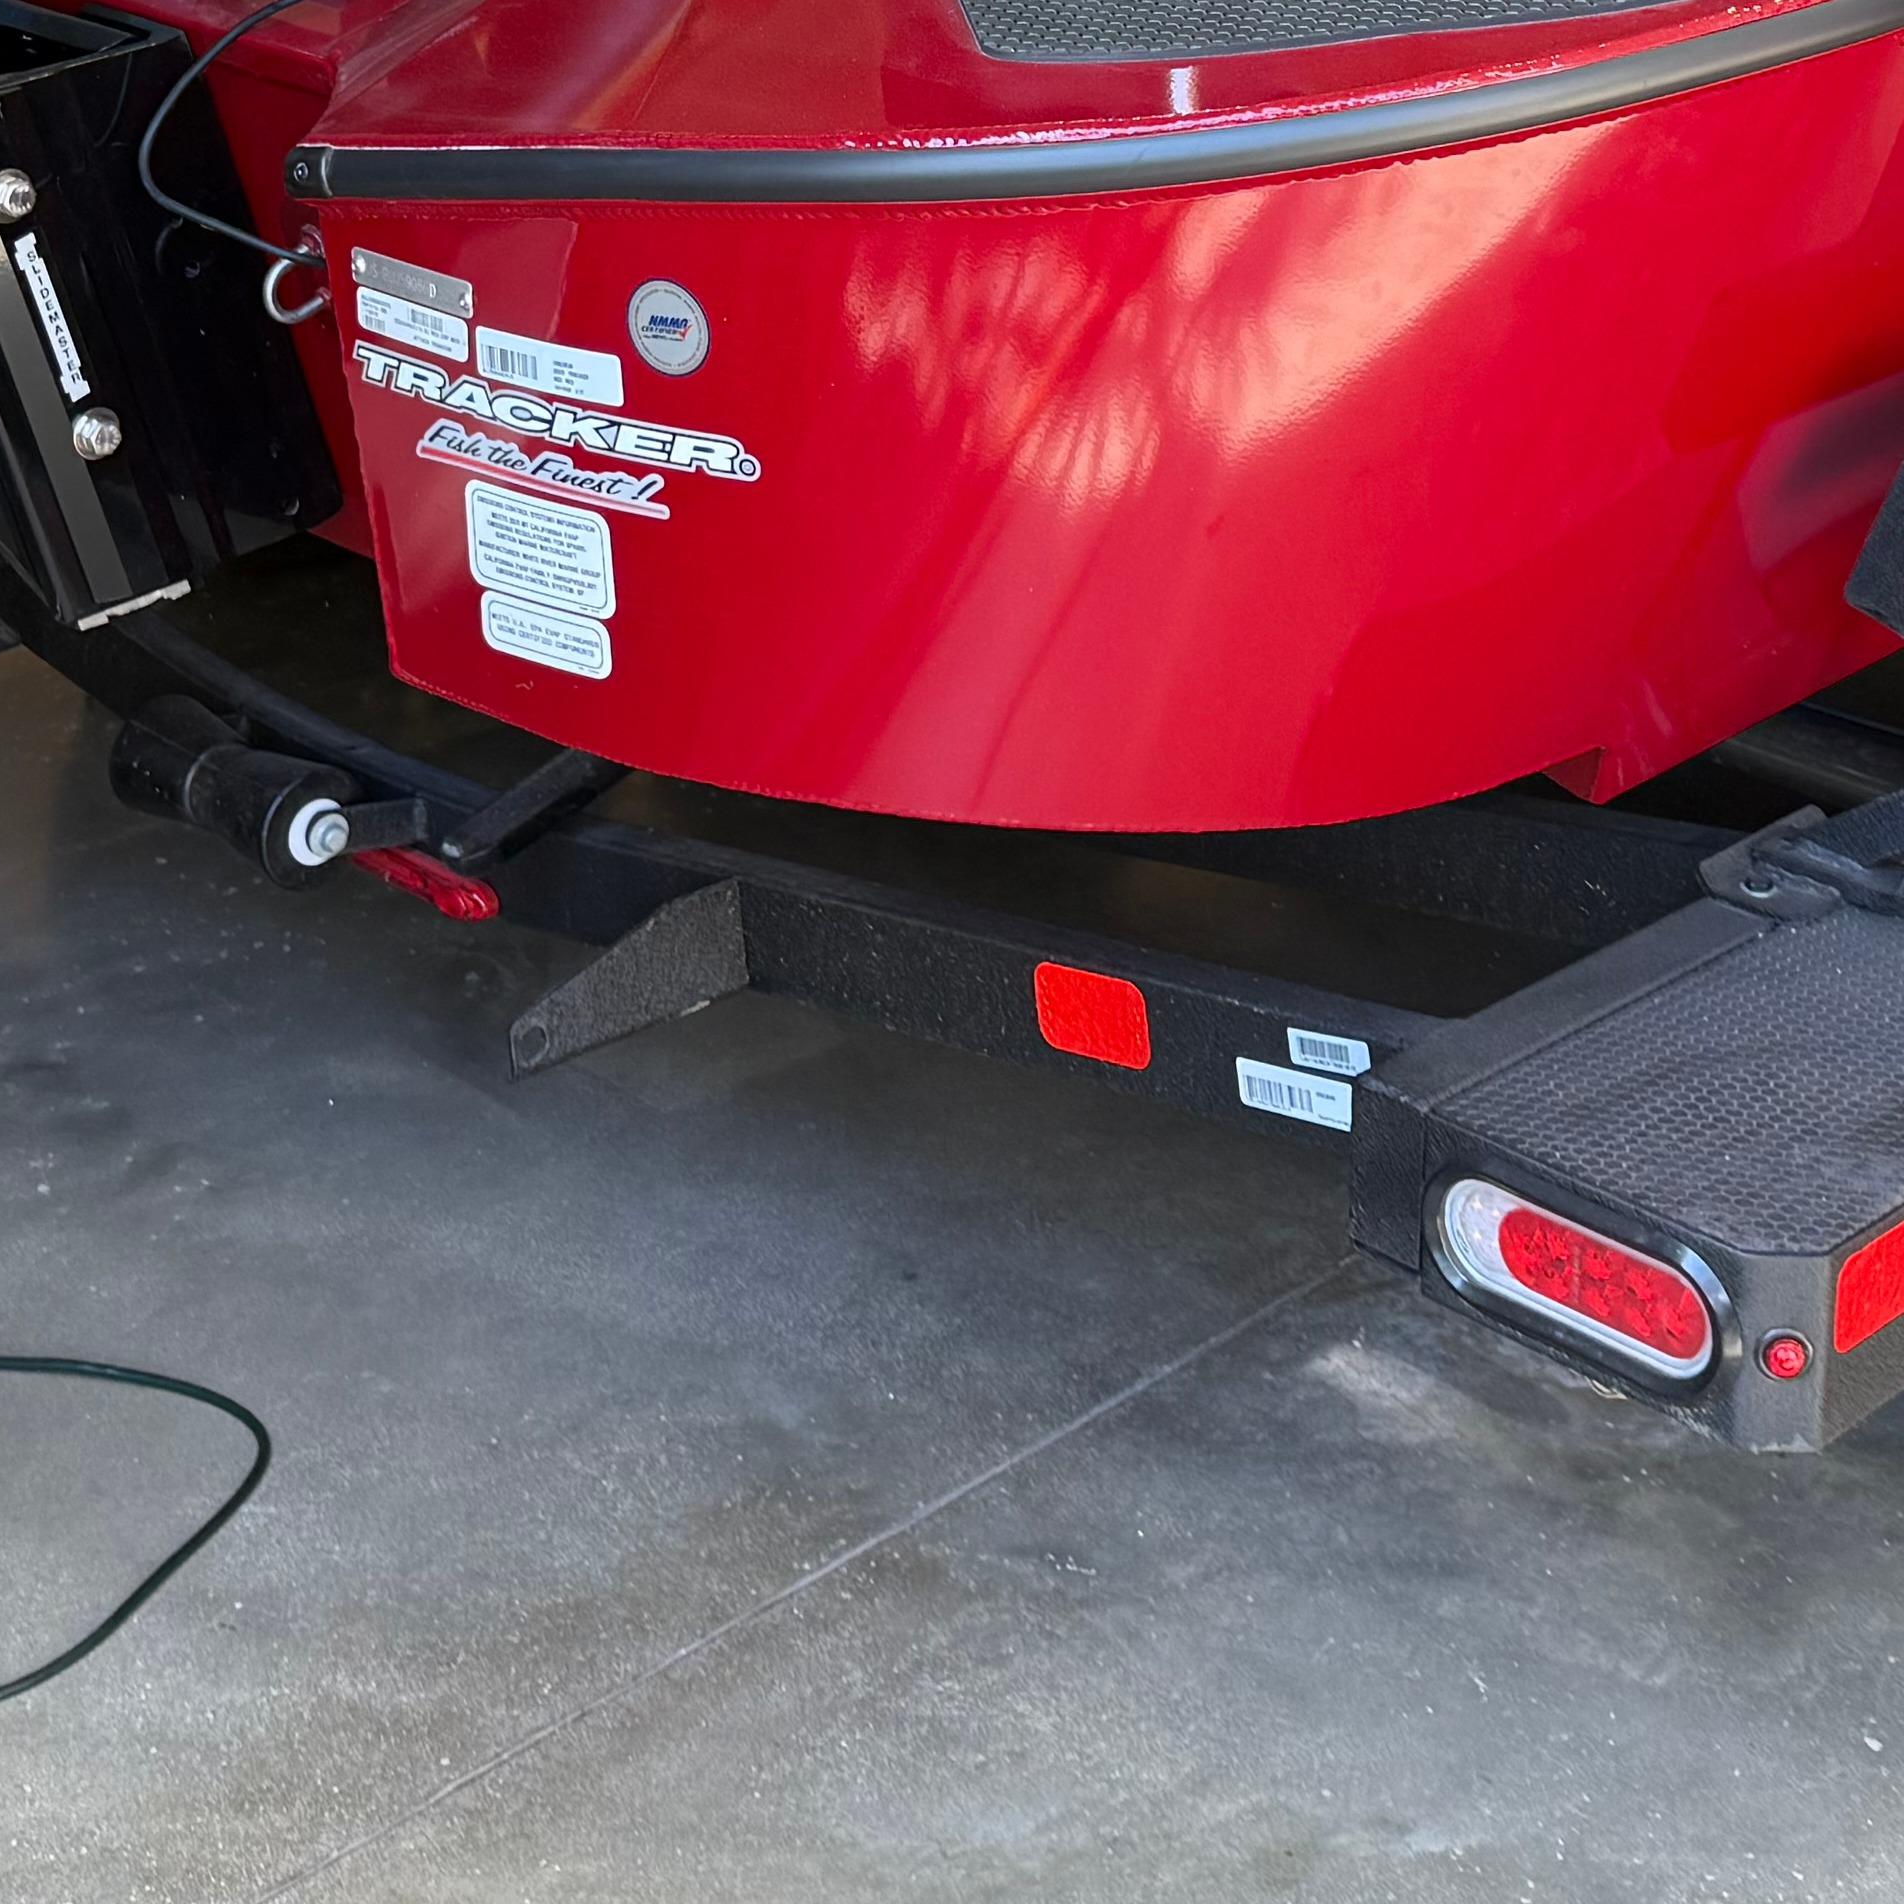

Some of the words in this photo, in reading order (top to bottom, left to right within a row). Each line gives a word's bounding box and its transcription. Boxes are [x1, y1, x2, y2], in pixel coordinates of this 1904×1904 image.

[26, 249, 82, 385] SLIDEMASTER
[354, 343, 742, 477] TRACKER
[428, 424, 483, 458] Fish
[487, 444, 528, 472] the
